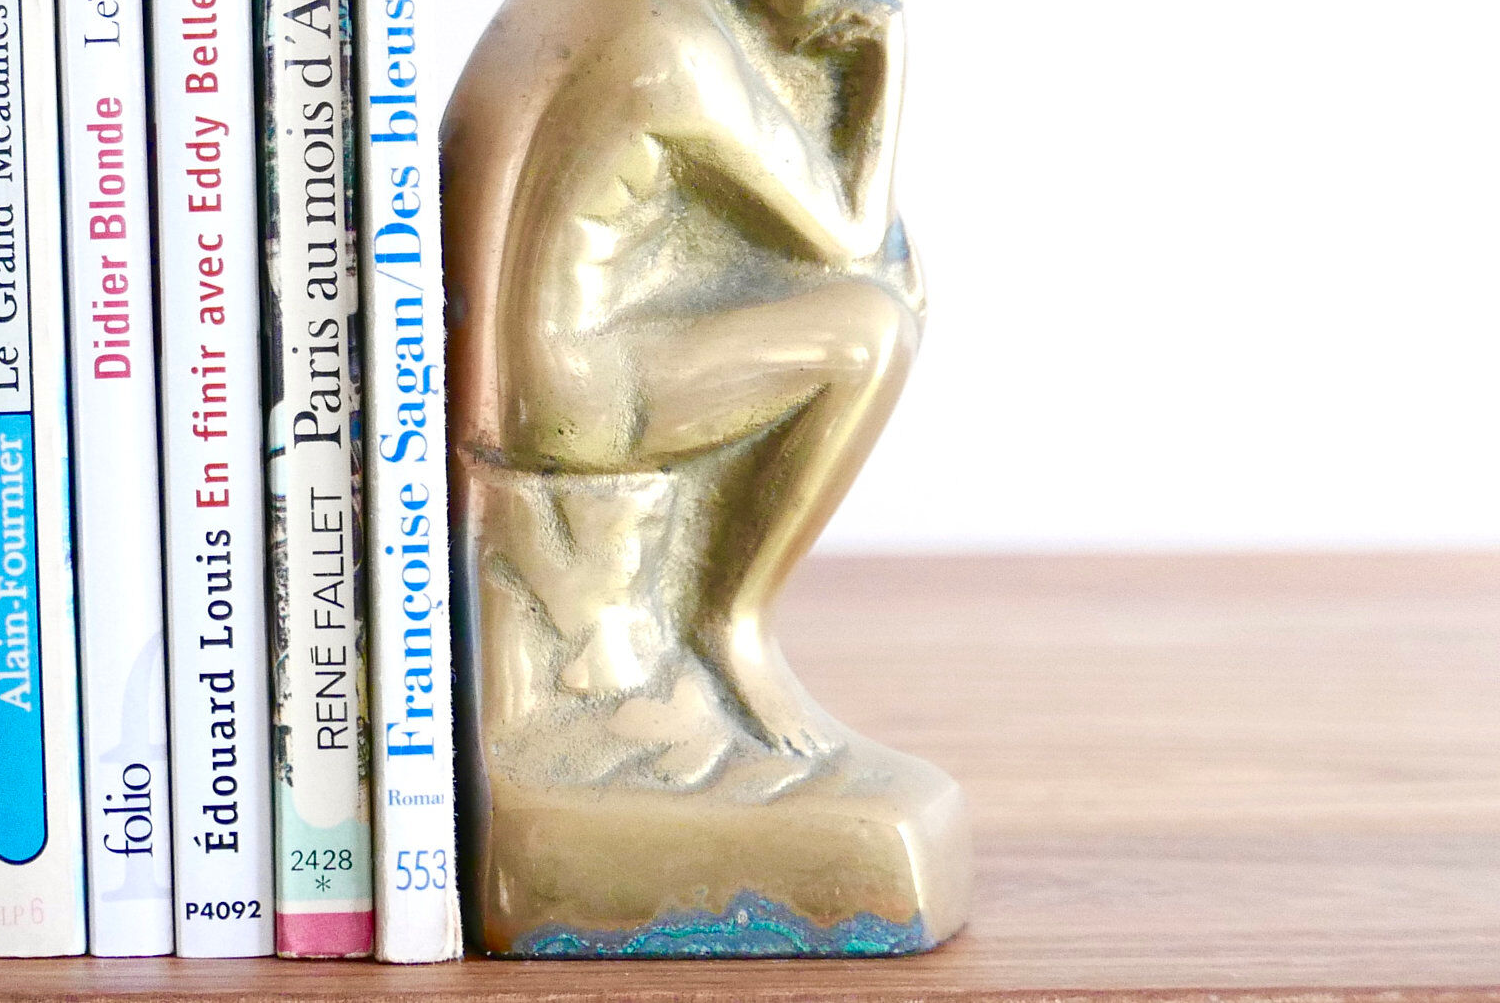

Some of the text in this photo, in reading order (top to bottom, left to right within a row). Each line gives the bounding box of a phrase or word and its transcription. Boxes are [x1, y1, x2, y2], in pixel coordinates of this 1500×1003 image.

[185, 115, 230, 213] Eddy
[285, 101, 337, 229] mois
[87, 97, 131, 379] Didier Blonde
[198, 233, 225, 325] avec
[306, 237, 339, 301] au
[374, 166, 438, 463] Sagan/Des
[191, 347, 228, 442] finir
[293, 318, 342, 449] Paris
[196, 462, 230, 508] En
[310, 486, 348, 751] RENÉ FALLET
[386, 483, 444, 761] Françoise
[193, 528, 239, 853] Édouard Louis
[103, 763, 153, 858] folio
[291, 849, 352, 871] 2428
[396, 849, 447, 890] 553
[186, 900, 262, 920] P4092
